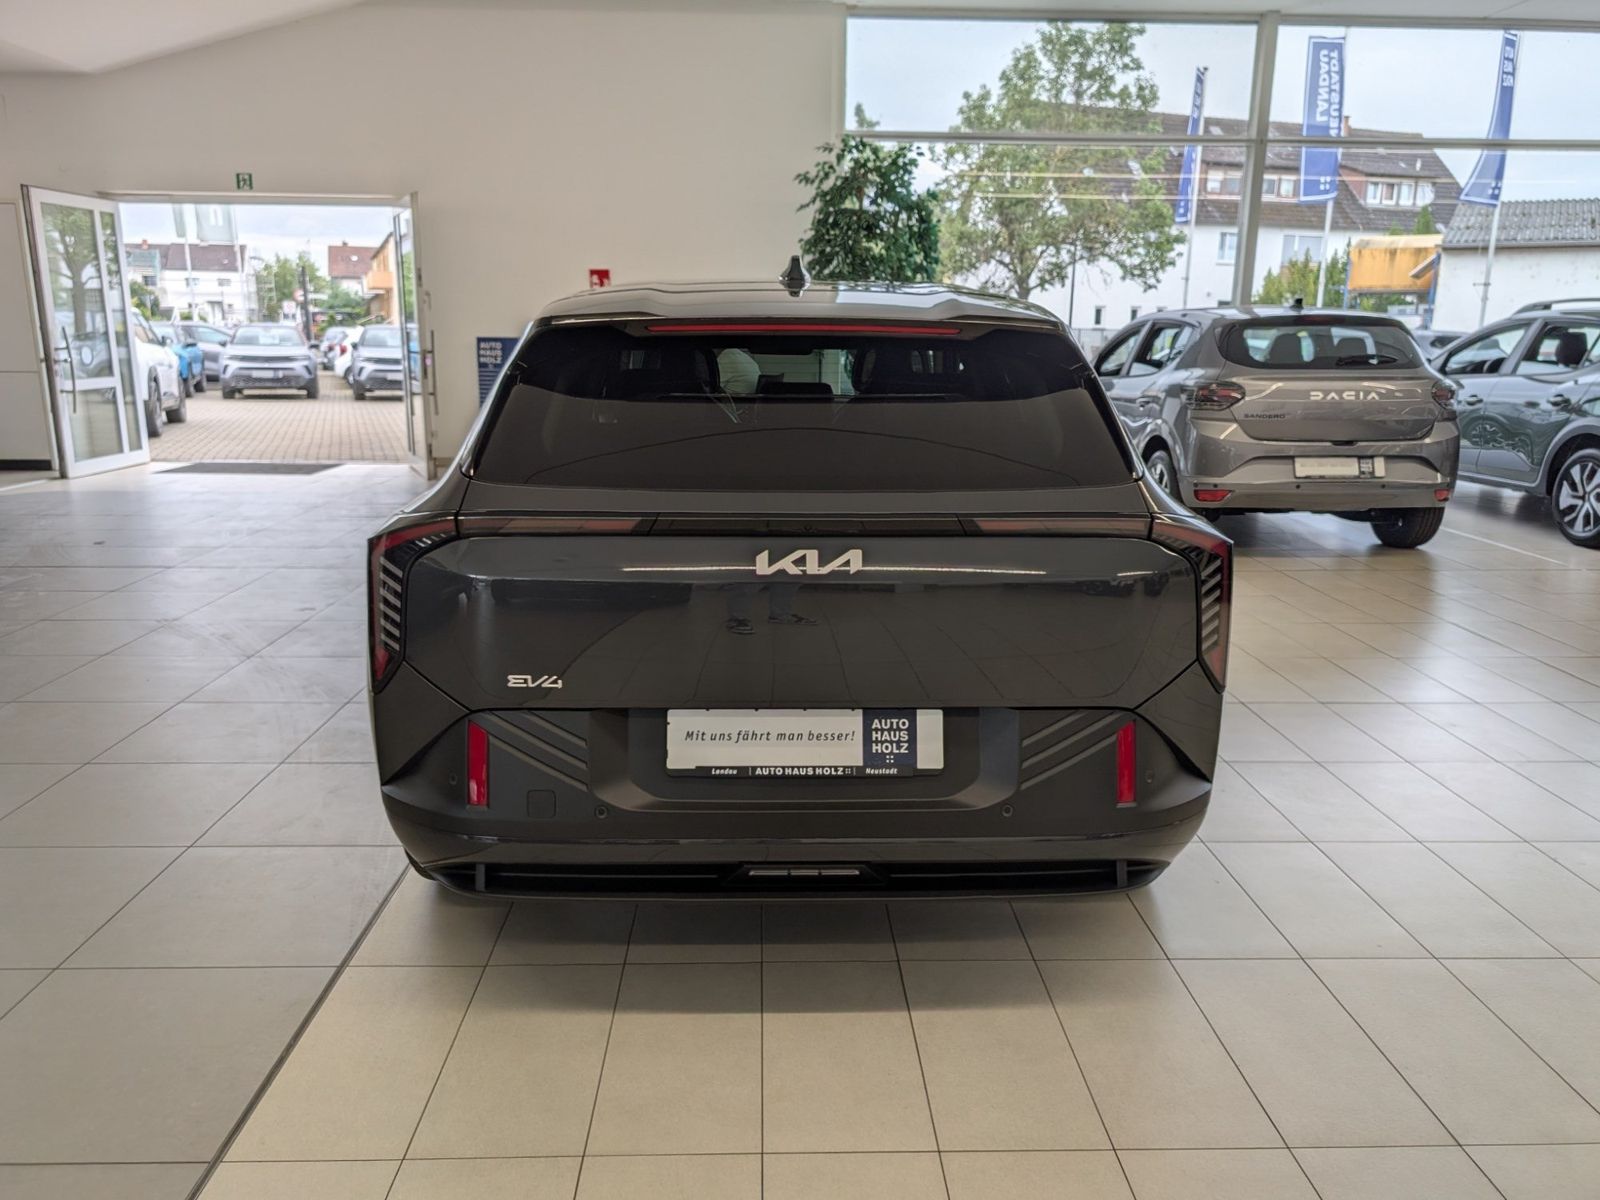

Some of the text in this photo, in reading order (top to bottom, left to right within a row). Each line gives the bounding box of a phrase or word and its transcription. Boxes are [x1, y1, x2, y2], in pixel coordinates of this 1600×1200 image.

[1309, 391, 1380, 401] DACIA
[755, 549, 863, 575] KIA
[507, 674, 563, 689] EV4
[871, 719, 909, 729] AUTO
[684, 730, 856, 743] Mit uns fährt man besser!
[872, 731, 909, 741] HAUS
[872, 743, 909, 753] HOLZ
[755, 767, 844, 775] AUTO HAUS HOLZ
[865, 767, 898, 775] Neustadt
